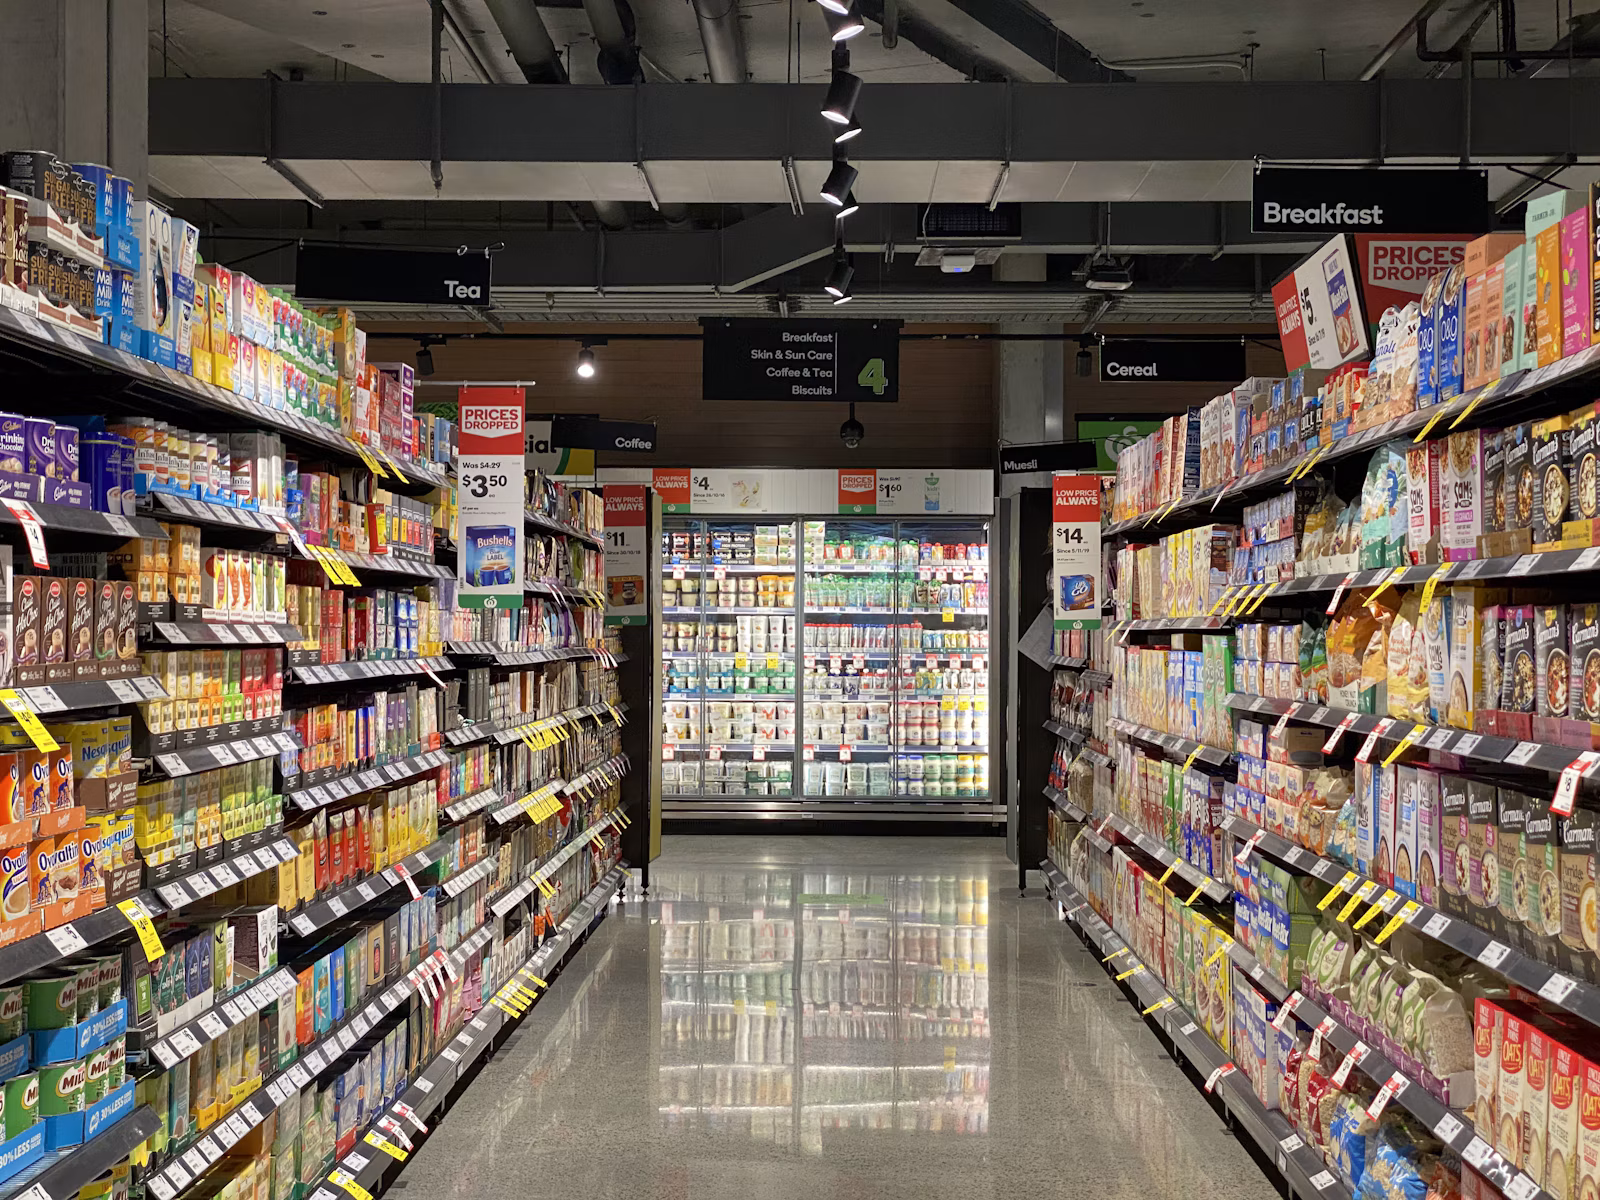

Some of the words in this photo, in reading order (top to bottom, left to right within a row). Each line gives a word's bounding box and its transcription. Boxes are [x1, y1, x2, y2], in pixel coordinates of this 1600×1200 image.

[1263, 202, 1383, 225] Breakfast
[1373, 246, 1464, 266] PRICES
[96, 270, 112, 284] Mal
[1373, 267, 1441, 280] DROPP
[444, 280, 481, 298] Tea
[122, 307, 133, 316] Drin
[1281, 310, 1301, 336] ALWAYS
[782, 332, 833, 343] Breakfast
[751, 349, 773, 360] Skin
[775, 350, 784, 360] &
[785, 350, 806, 360] Sun
[807, 350, 833, 360] Care
[766, 367, 800, 377] Coffee
[802, 368, 810, 378] &
[812, 368, 833, 378] Tea
[1106, 362, 1158, 376] Cereal
[858, 358, 888, 395] 4
[792, 386, 832, 395] Biscuits
[466, 409, 518, 420] PRICES
[465, 422, 518, 430] DROPPED
[0, 432, 24, 444] rinking
[614, 436, 652, 449] Coffee
[0, 442, 24, 452] hocolat
[1532, 434, 1558, 466] Carman's
[1004, 459, 1038, 470] Muesli
[1485, 450, 1504, 470] Carman
[694, 476, 709, 490] $4
[1056, 497, 1098, 506] ALWAYS
[478, 536, 512, 548] Bushells
[606, 532, 625, 546] $11
[1057, 528, 1083, 544] $14
[1506, 622, 1530, 646] arman's
[1572, 620, 1599, 644] Carman's
[82, 746, 108, 762] Nesq
[1443, 788, 1465, 808] Carman's
[1470, 794, 1492, 815] Carman's
[1526, 812, 1552, 834] Carman's
[114, 822, 134, 845] quik
[2, 851, 28, 874] Ovalti
[1480, 1004, 1489, 1016] UNCLE
[103, 1016, 115, 1029] LESS
[1508, 1018, 1520, 1032] UNCLE
[1531, 1032, 1542, 1045] UNCLE
[0, 1050, 13, 1064] ESS
[1503, 1041, 1521, 1064] OATS
[1557, 1048, 1571, 1062] UNCLE
[1552, 1073, 1572, 1099] OATS
[101, 1108, 112, 1122] 30%
[111, 1096, 124, 1114] LESS
[14, 1140, 30, 1160] LESS
